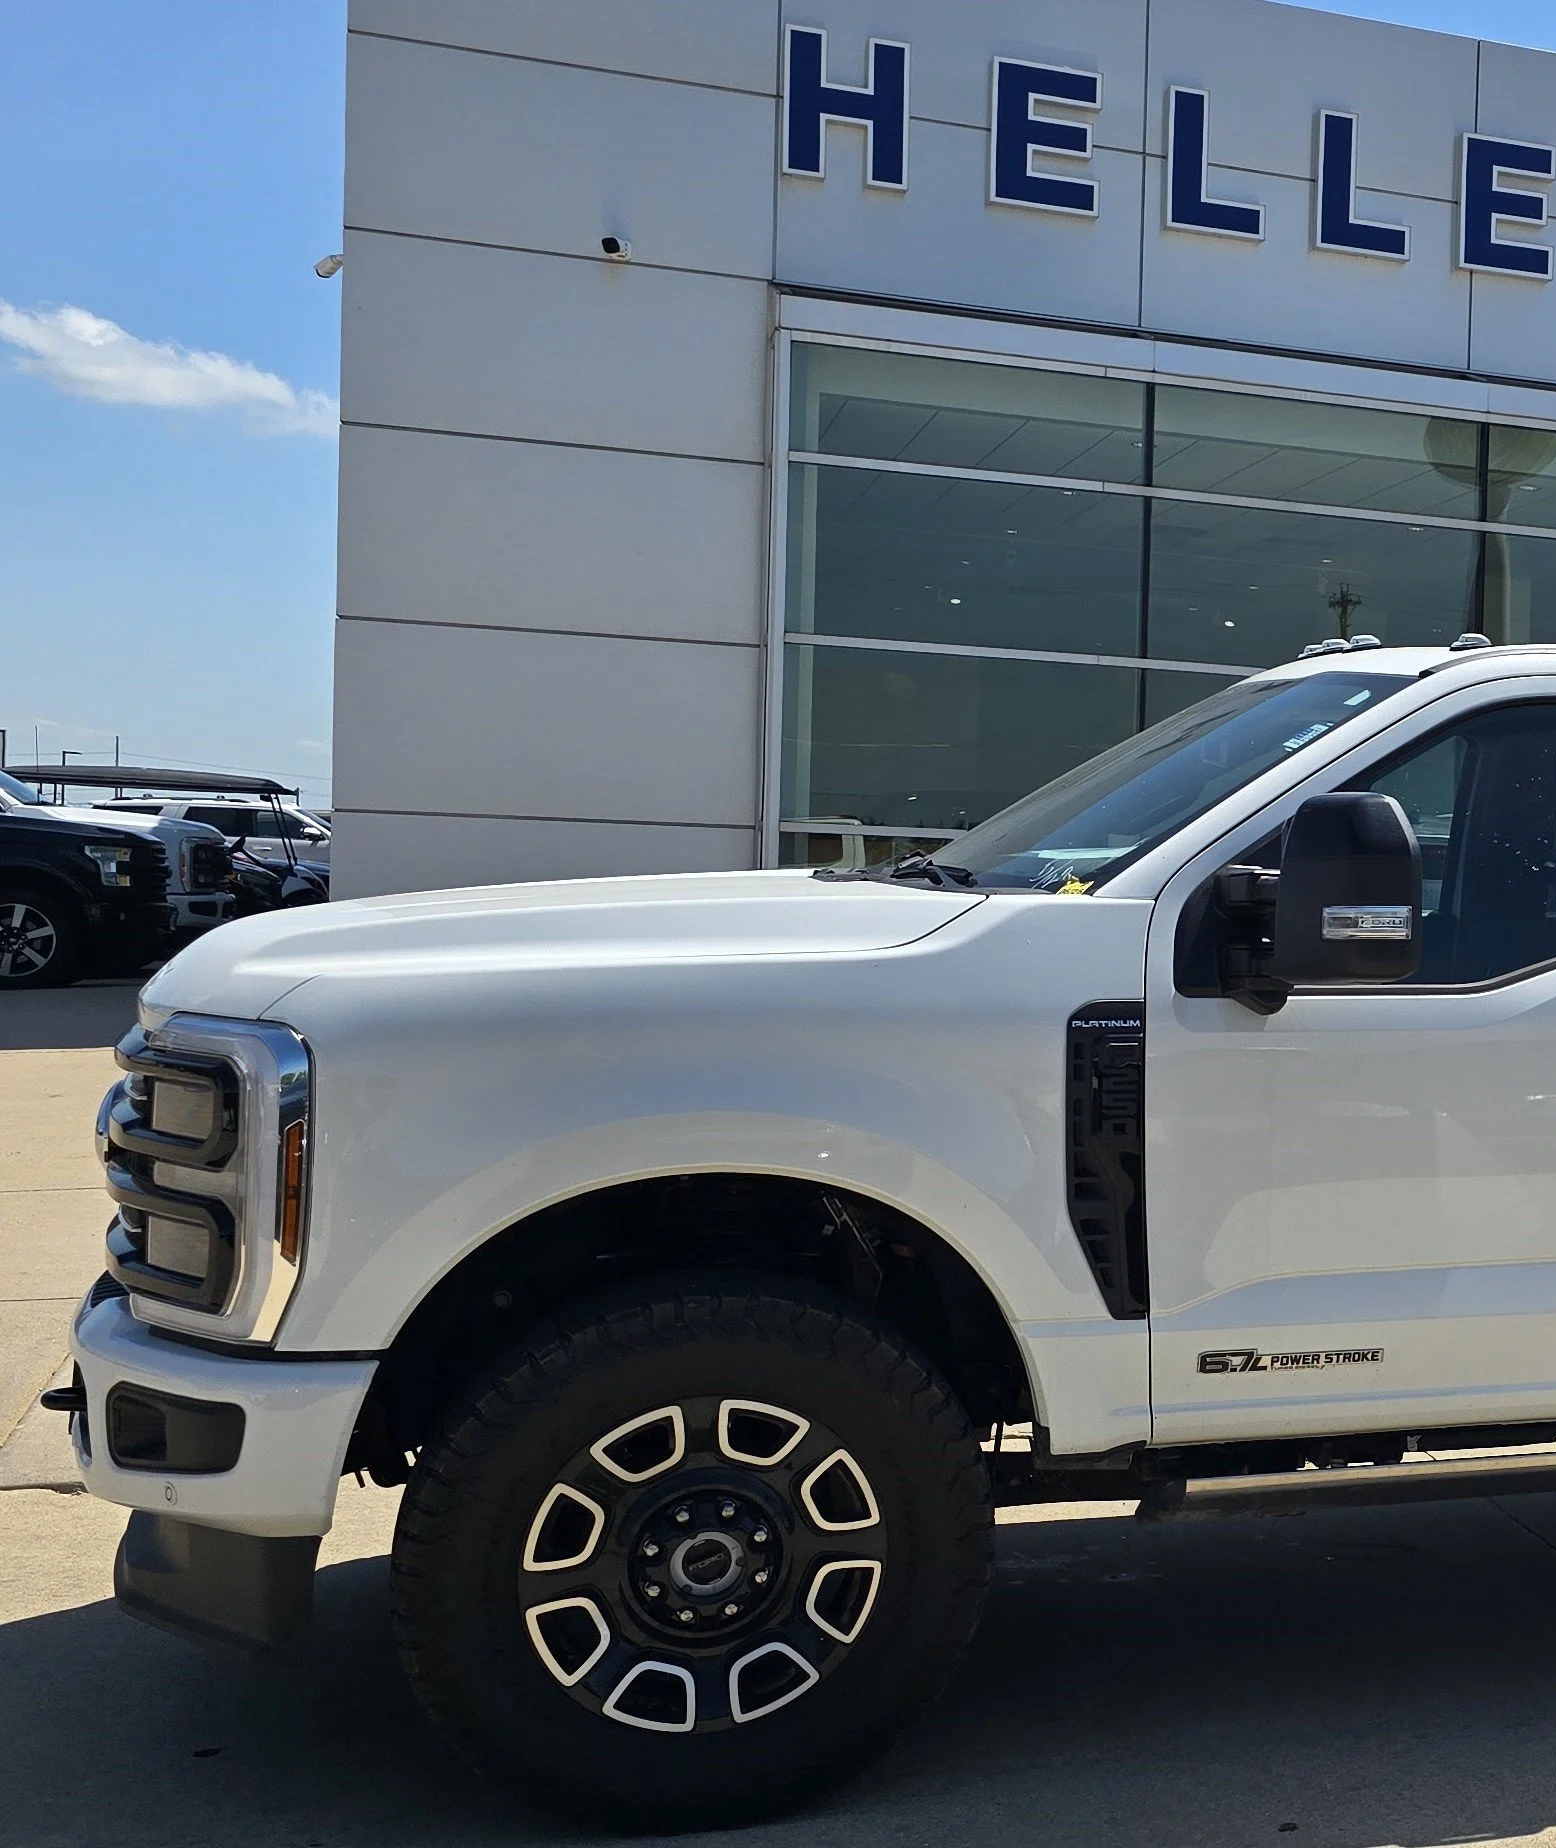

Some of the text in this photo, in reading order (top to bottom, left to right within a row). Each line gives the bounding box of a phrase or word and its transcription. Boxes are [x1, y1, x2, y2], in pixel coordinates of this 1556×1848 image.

[1071, 1019, 1141, 1028] PLATINUM
[1198, 1350, 1380, 1374] 6.7L POWER STROKE
